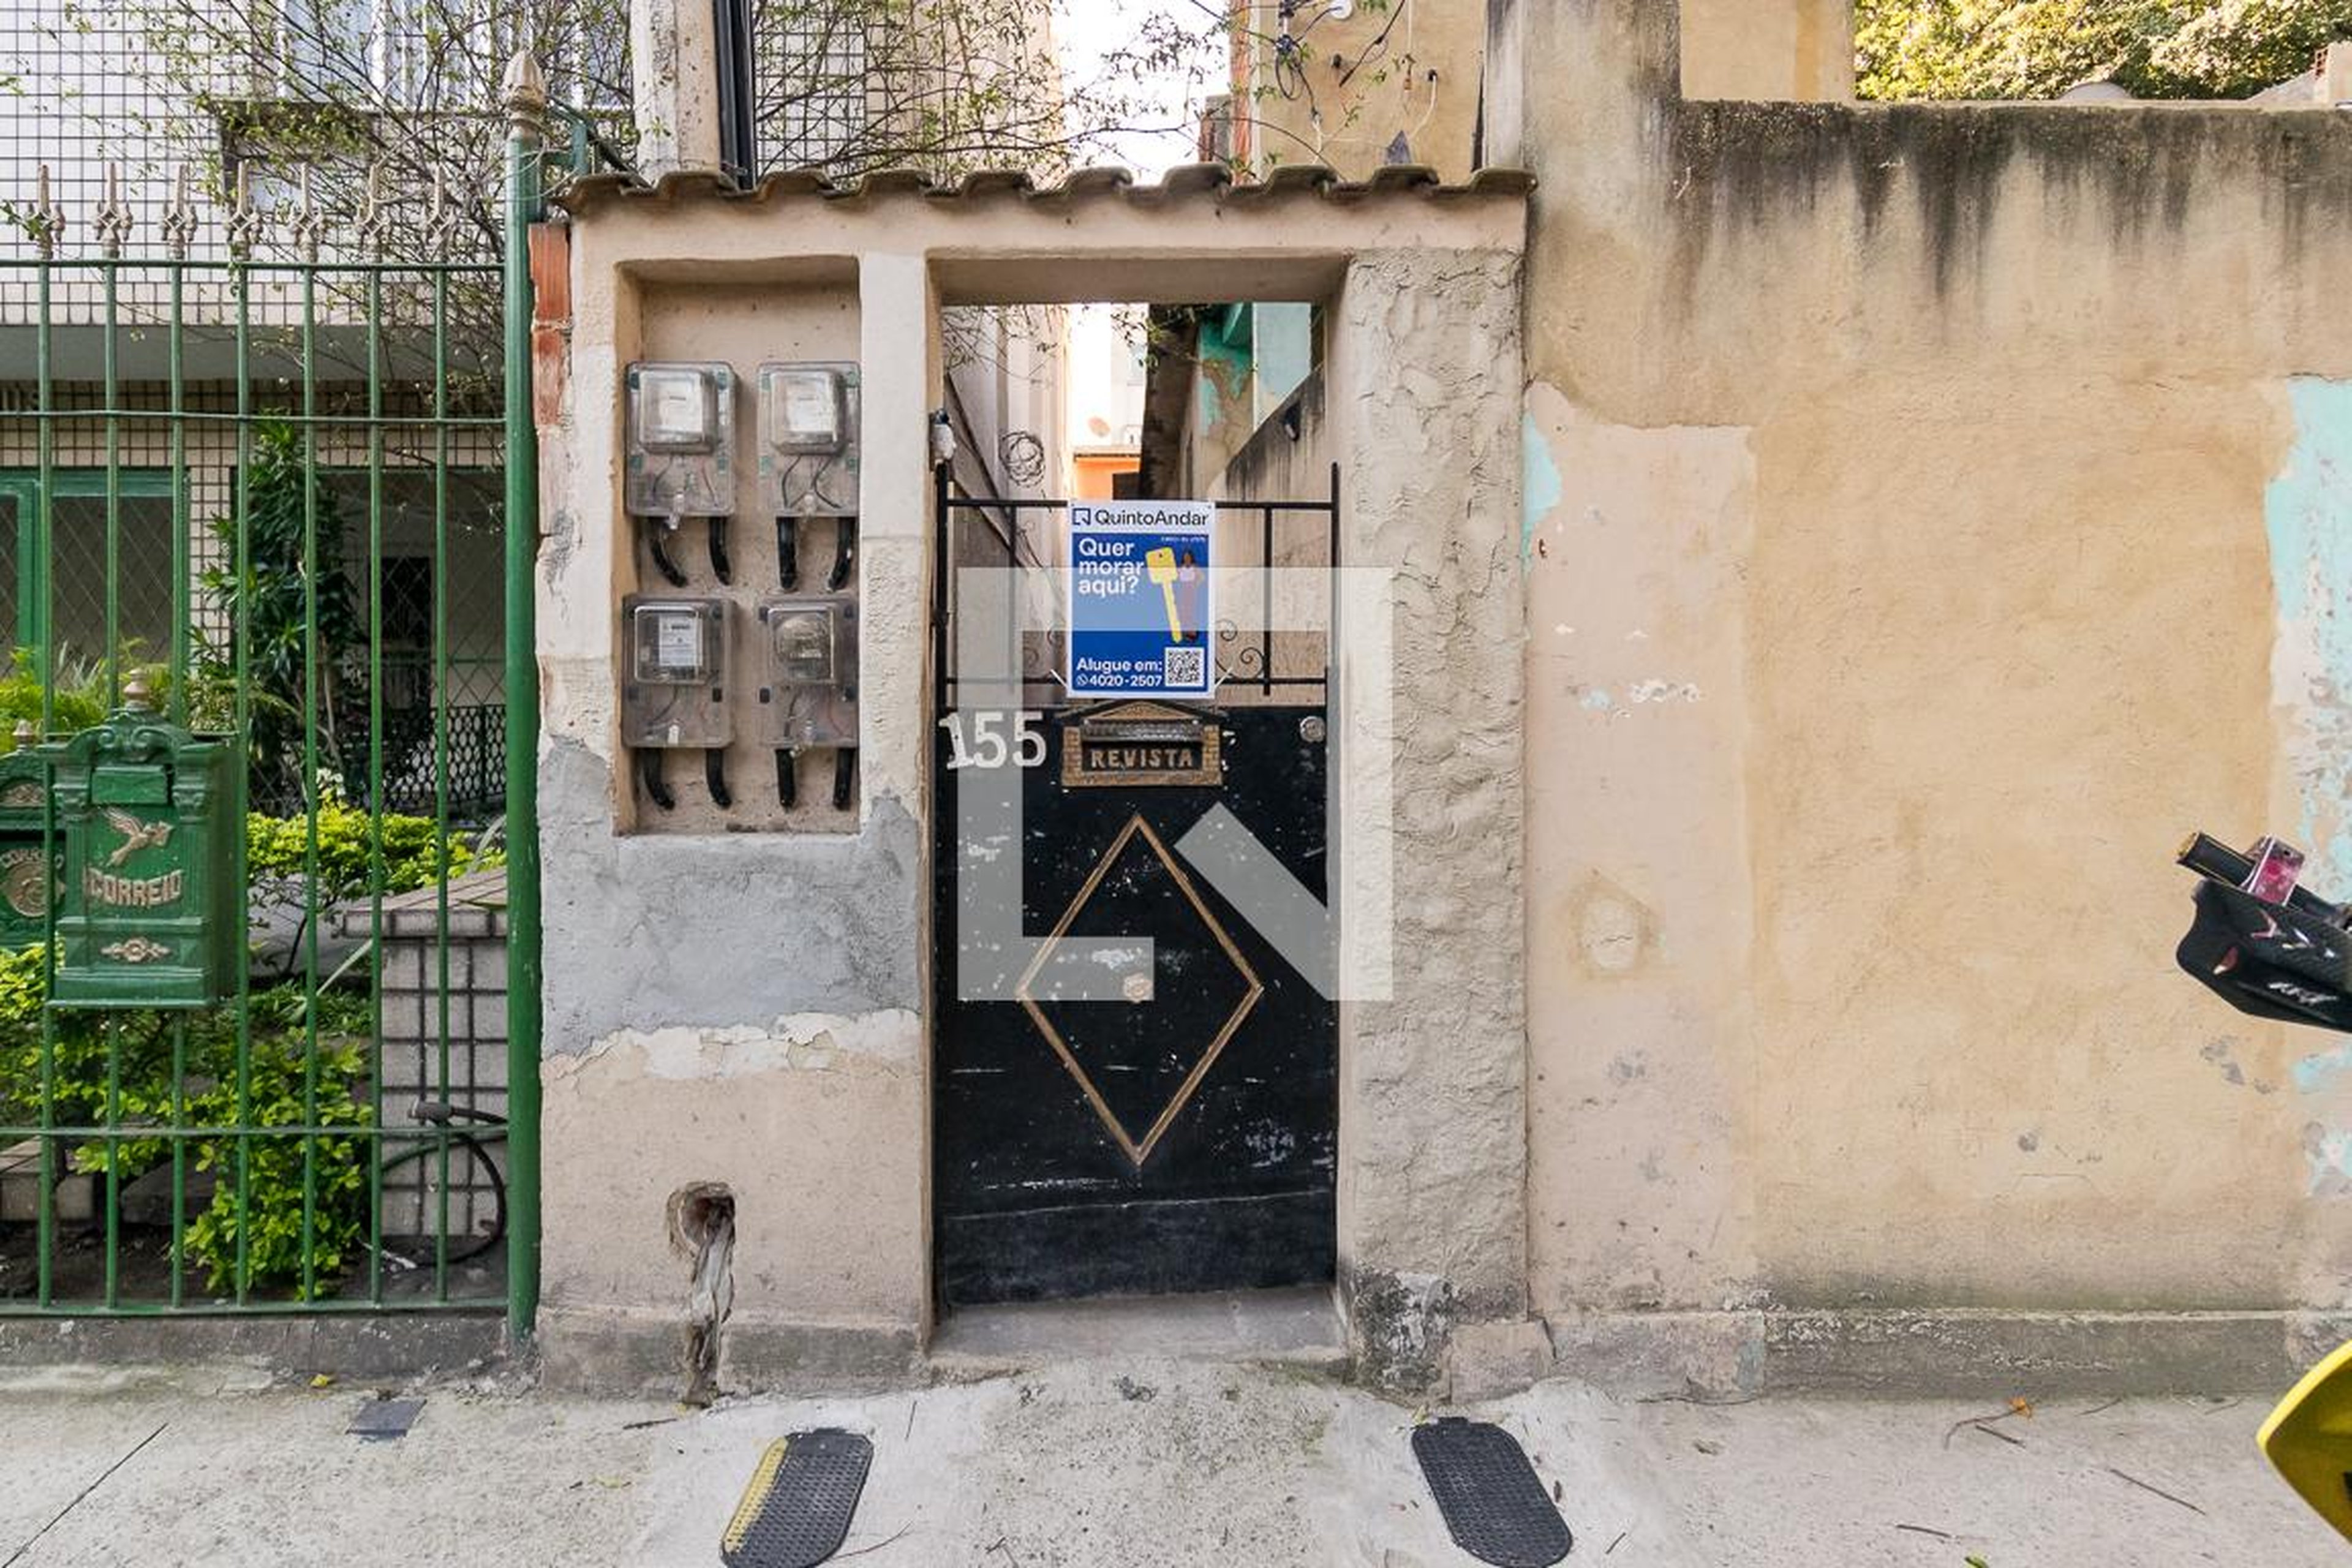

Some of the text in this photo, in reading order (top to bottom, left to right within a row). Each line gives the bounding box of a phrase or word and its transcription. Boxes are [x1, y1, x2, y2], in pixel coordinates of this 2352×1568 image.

[1095, 509, 1209, 526] QuintoAndar
[1079, 538, 1134, 557] Quer
[1079, 560, 1144, 575] morar
[1078, 577, 1138, 598] aqui?
[1077, 657, 1163, 675] Alugue em:
[1090, 675, 1163, 687] 4020-2507
[939, 711, 1047, 770] 155
[1091, 749, 1193, 768] REVISTA
[88, 867, 184, 907] CORREIO
